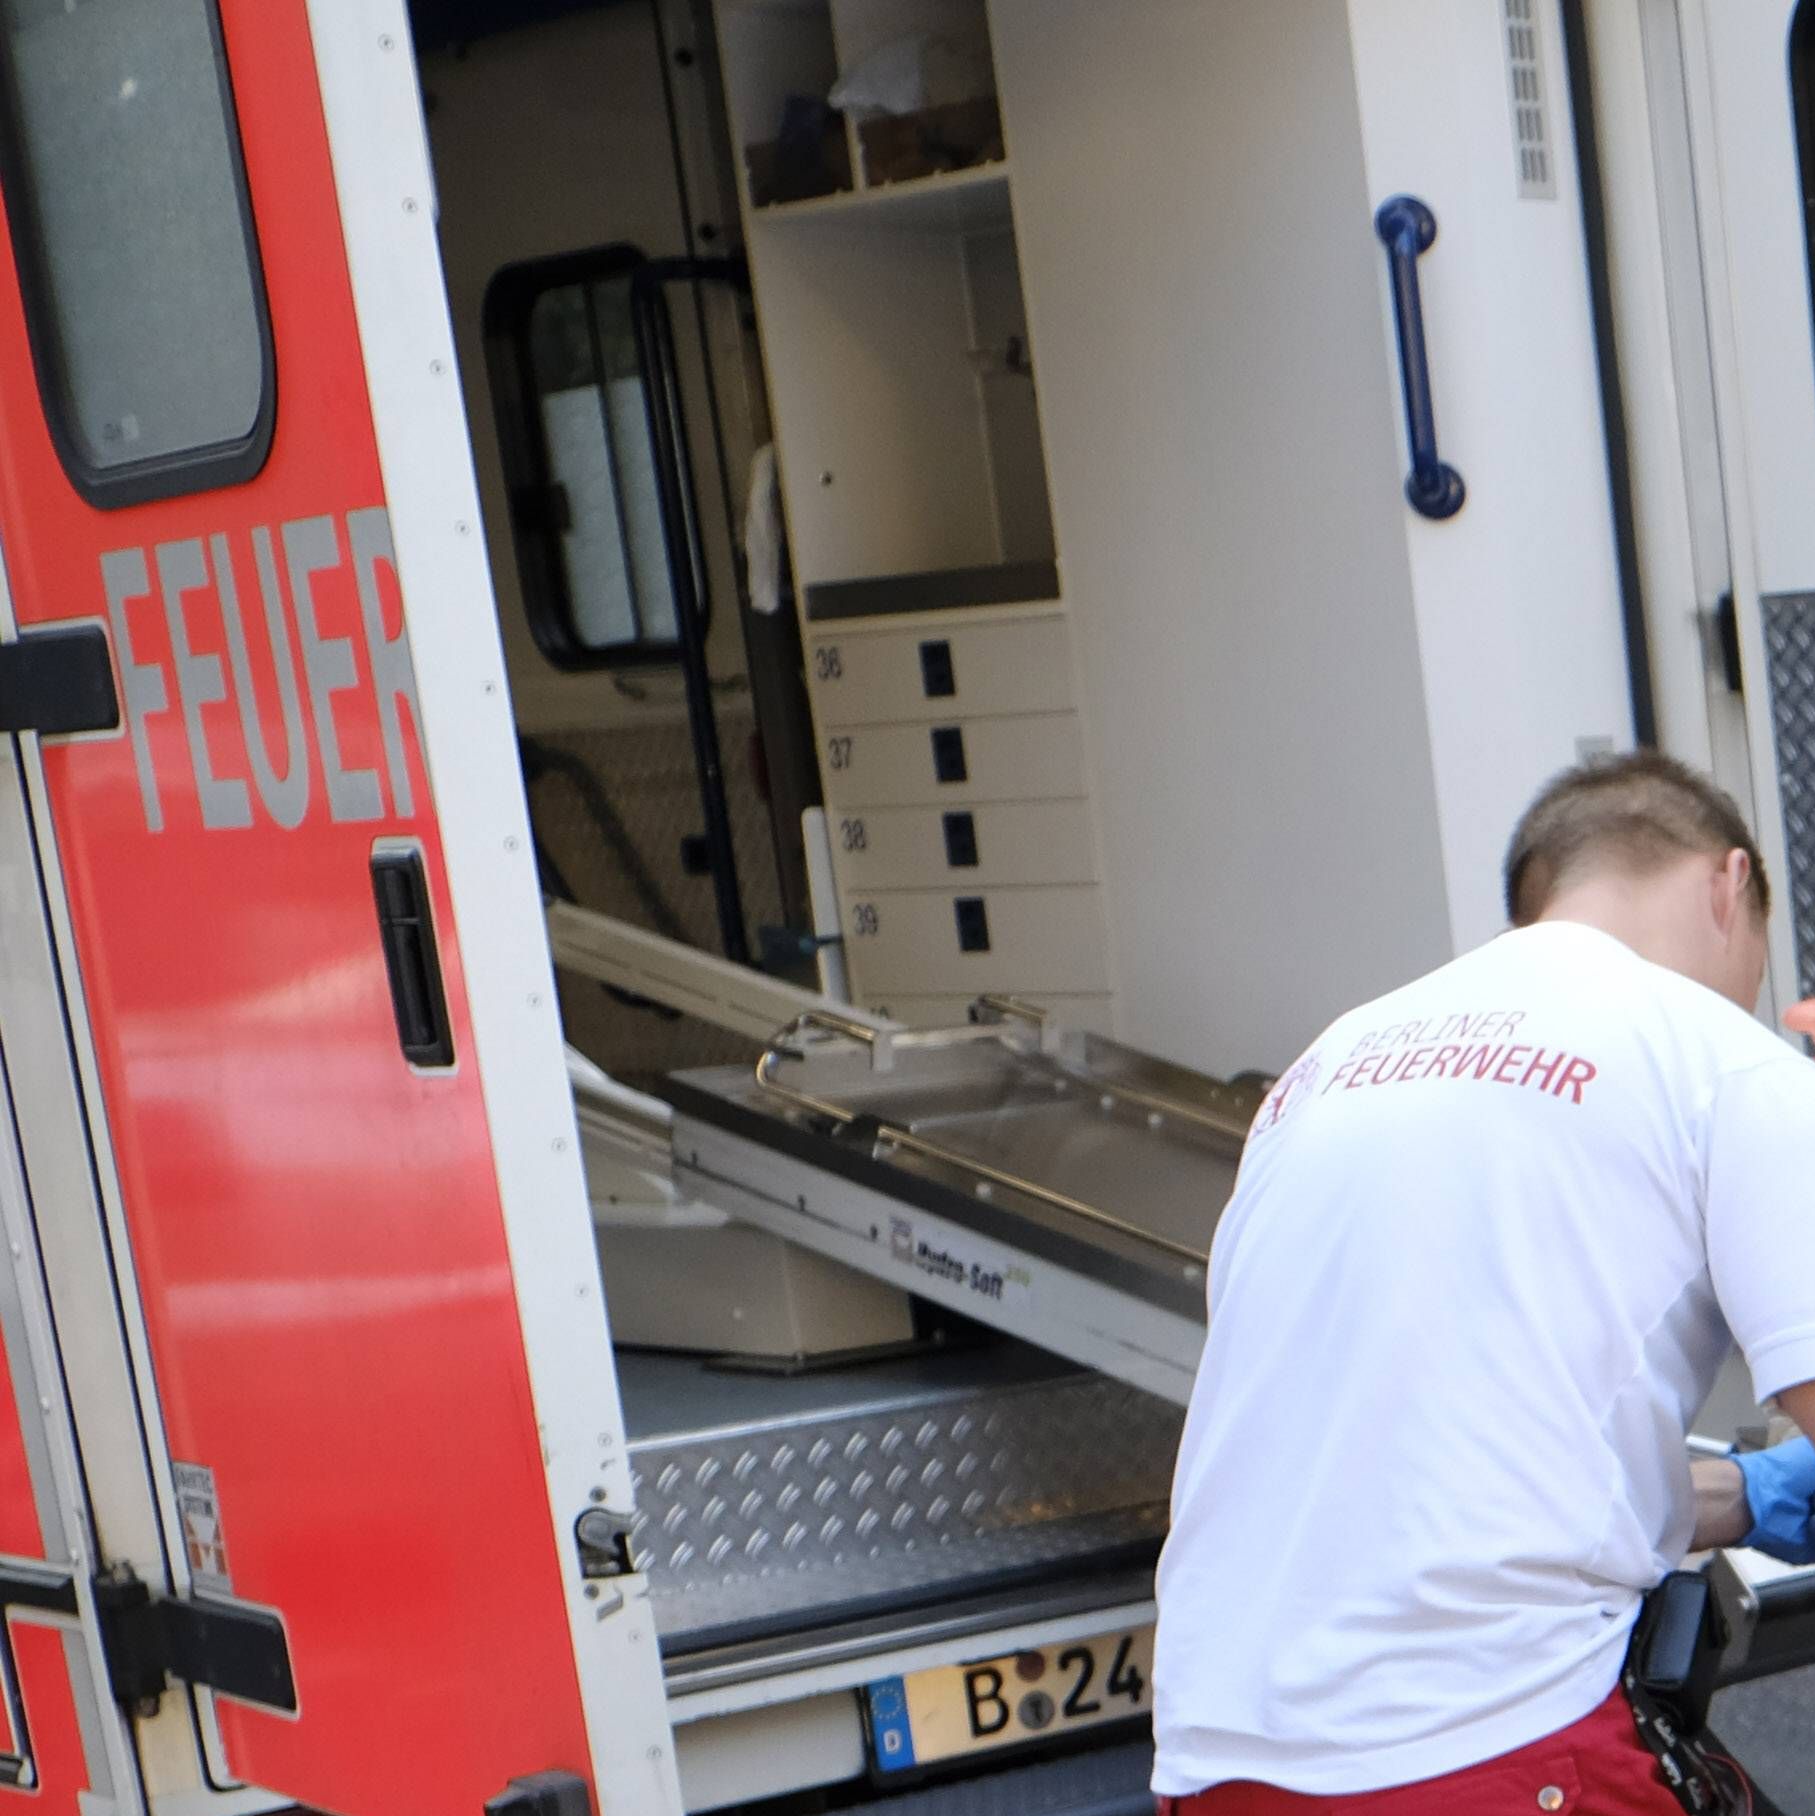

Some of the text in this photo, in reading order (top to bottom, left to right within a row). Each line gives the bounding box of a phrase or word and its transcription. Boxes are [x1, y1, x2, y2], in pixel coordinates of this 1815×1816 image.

[101, 505, 432, 833] FEUER
[829, 738, 852, 770] 37
[841, 820, 867, 852] 38
[853, 904, 879, 936] 39
[1349, 1010, 1527, 1058] BERLINER
[1321, 1043, 1598, 1105] FEUERWEHR
[964, 1635, 1144, 1738] B 24
[883, 1728, 901, 1755] D
